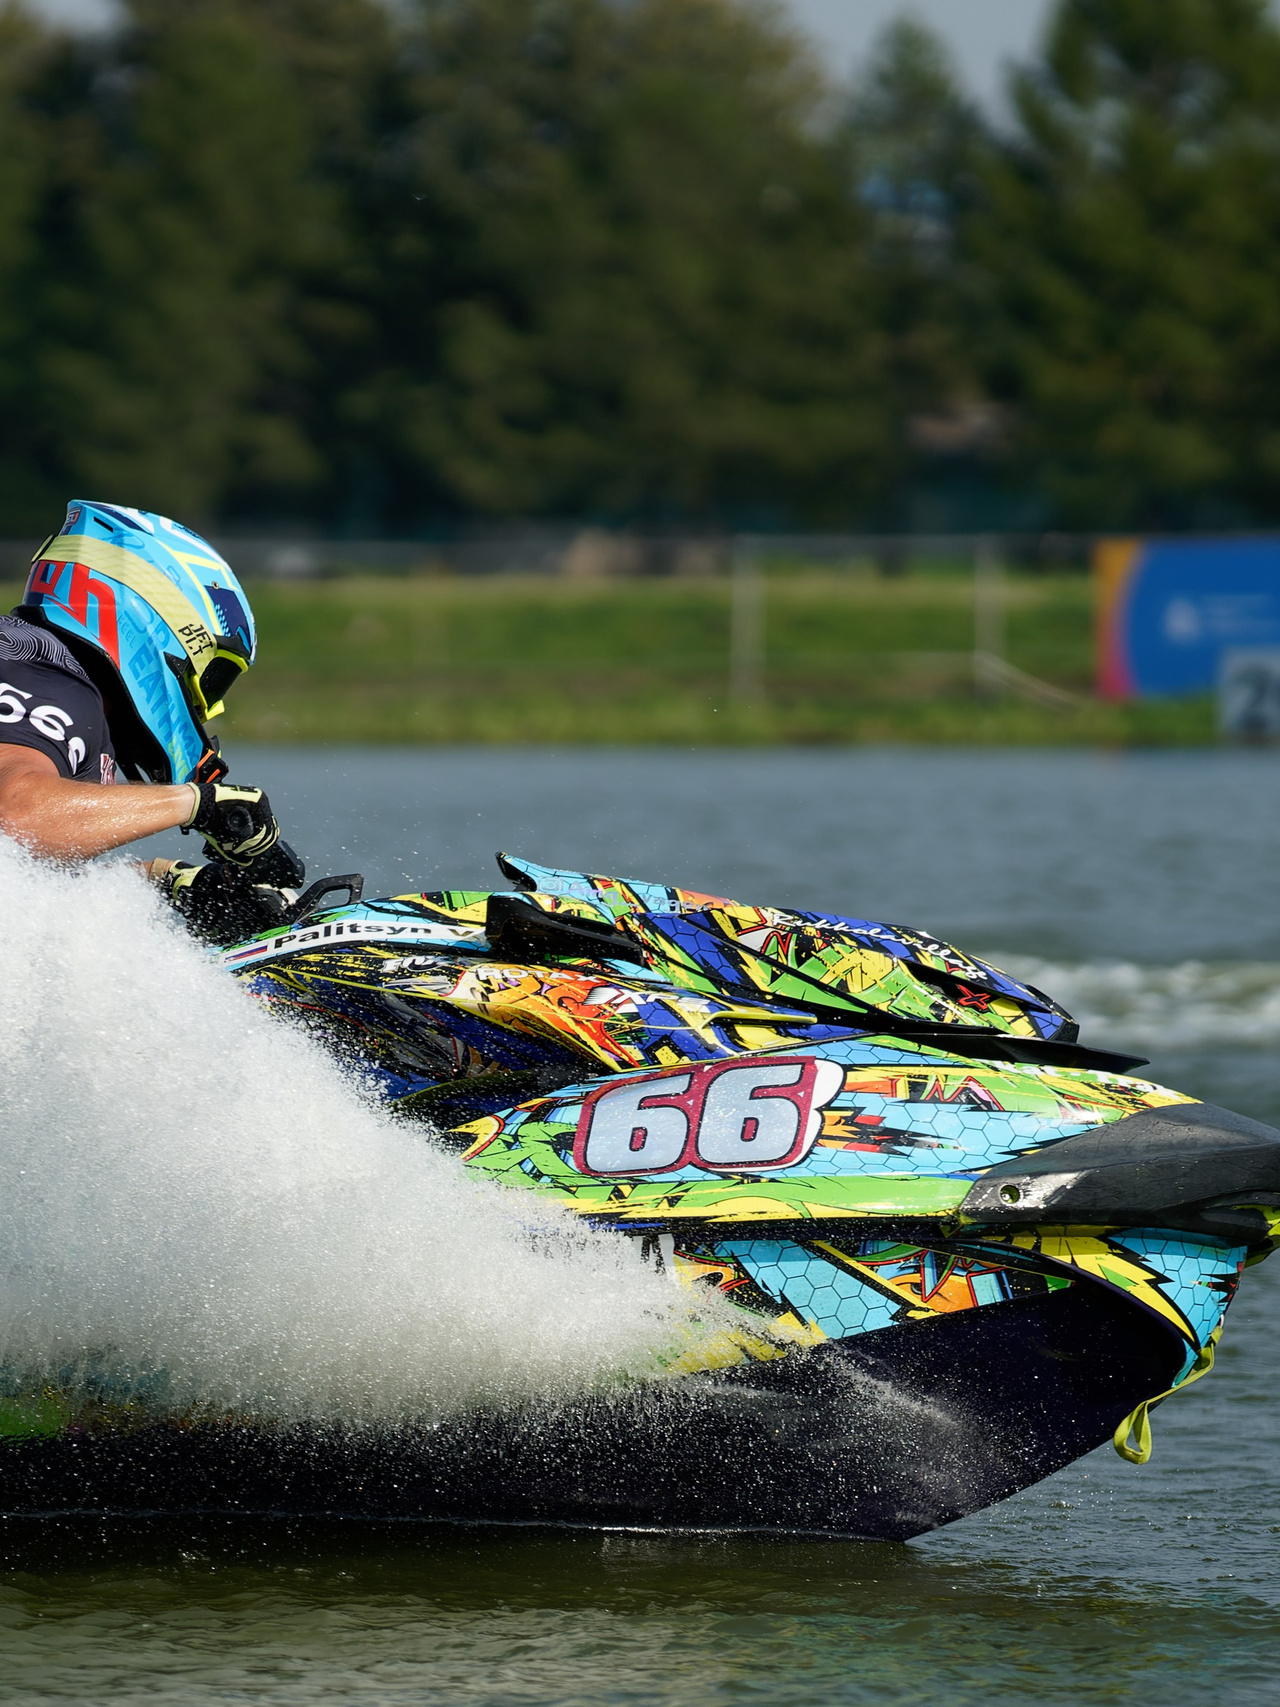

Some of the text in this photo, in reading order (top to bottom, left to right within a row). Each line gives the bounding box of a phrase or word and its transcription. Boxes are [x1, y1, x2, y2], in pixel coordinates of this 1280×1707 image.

[273, 921, 432, 949] Palitsyn
[476, 966, 602, 984] ROTAX
[580, 1057, 809, 1178] 66
